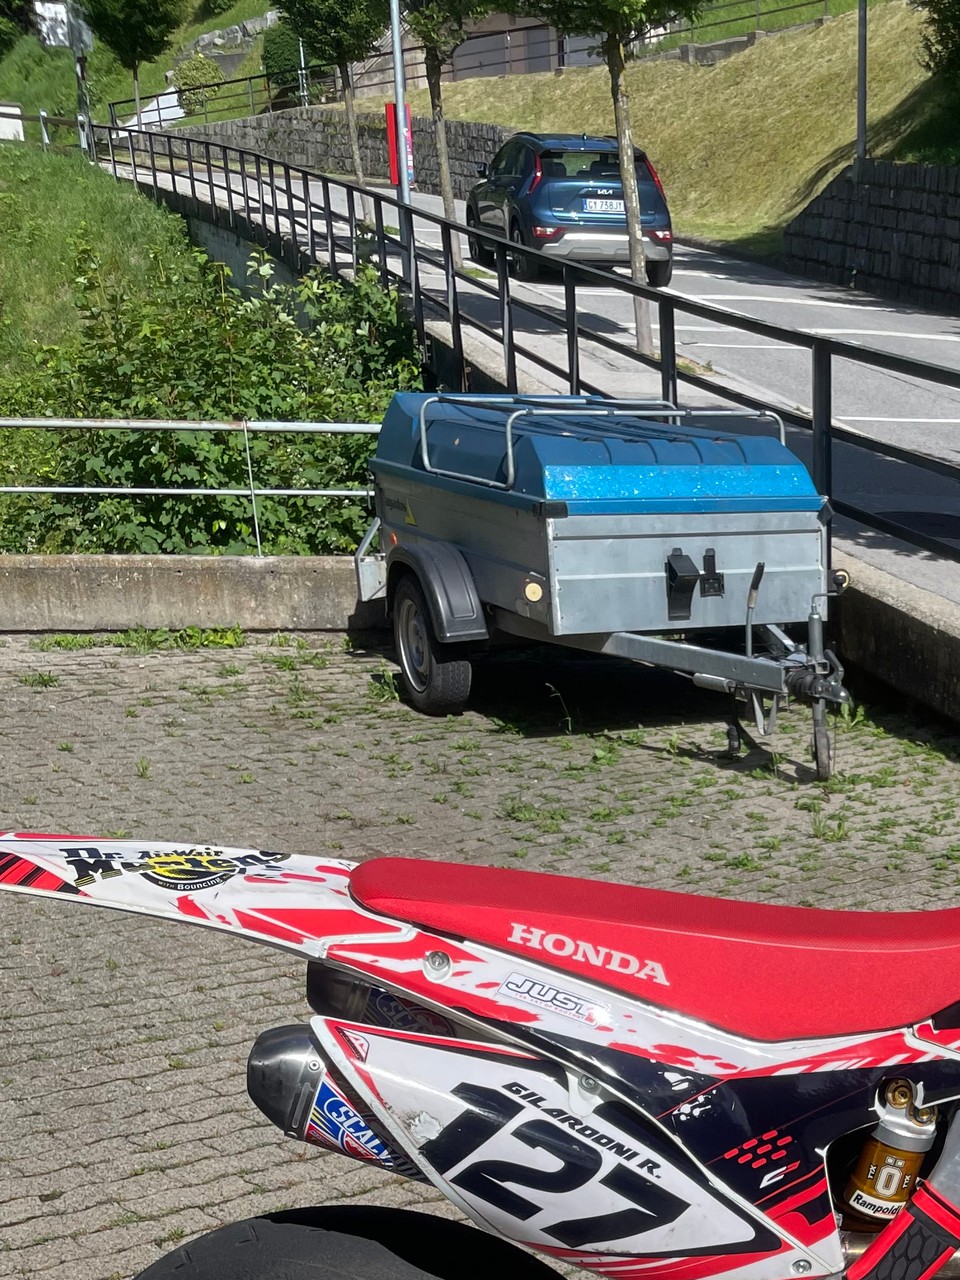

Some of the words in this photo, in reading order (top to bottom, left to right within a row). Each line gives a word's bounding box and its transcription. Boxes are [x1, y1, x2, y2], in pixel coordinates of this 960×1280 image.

[59, 847, 123, 859] Dr.
[177, 876, 223, 890] Bouncing
[507, 922, 670, 986] HONDA
[501, 1081, 642, 1163] GILARDONI
[637, 1158, 662, 1179] R.
[418, 1081, 692, 1248] 127
